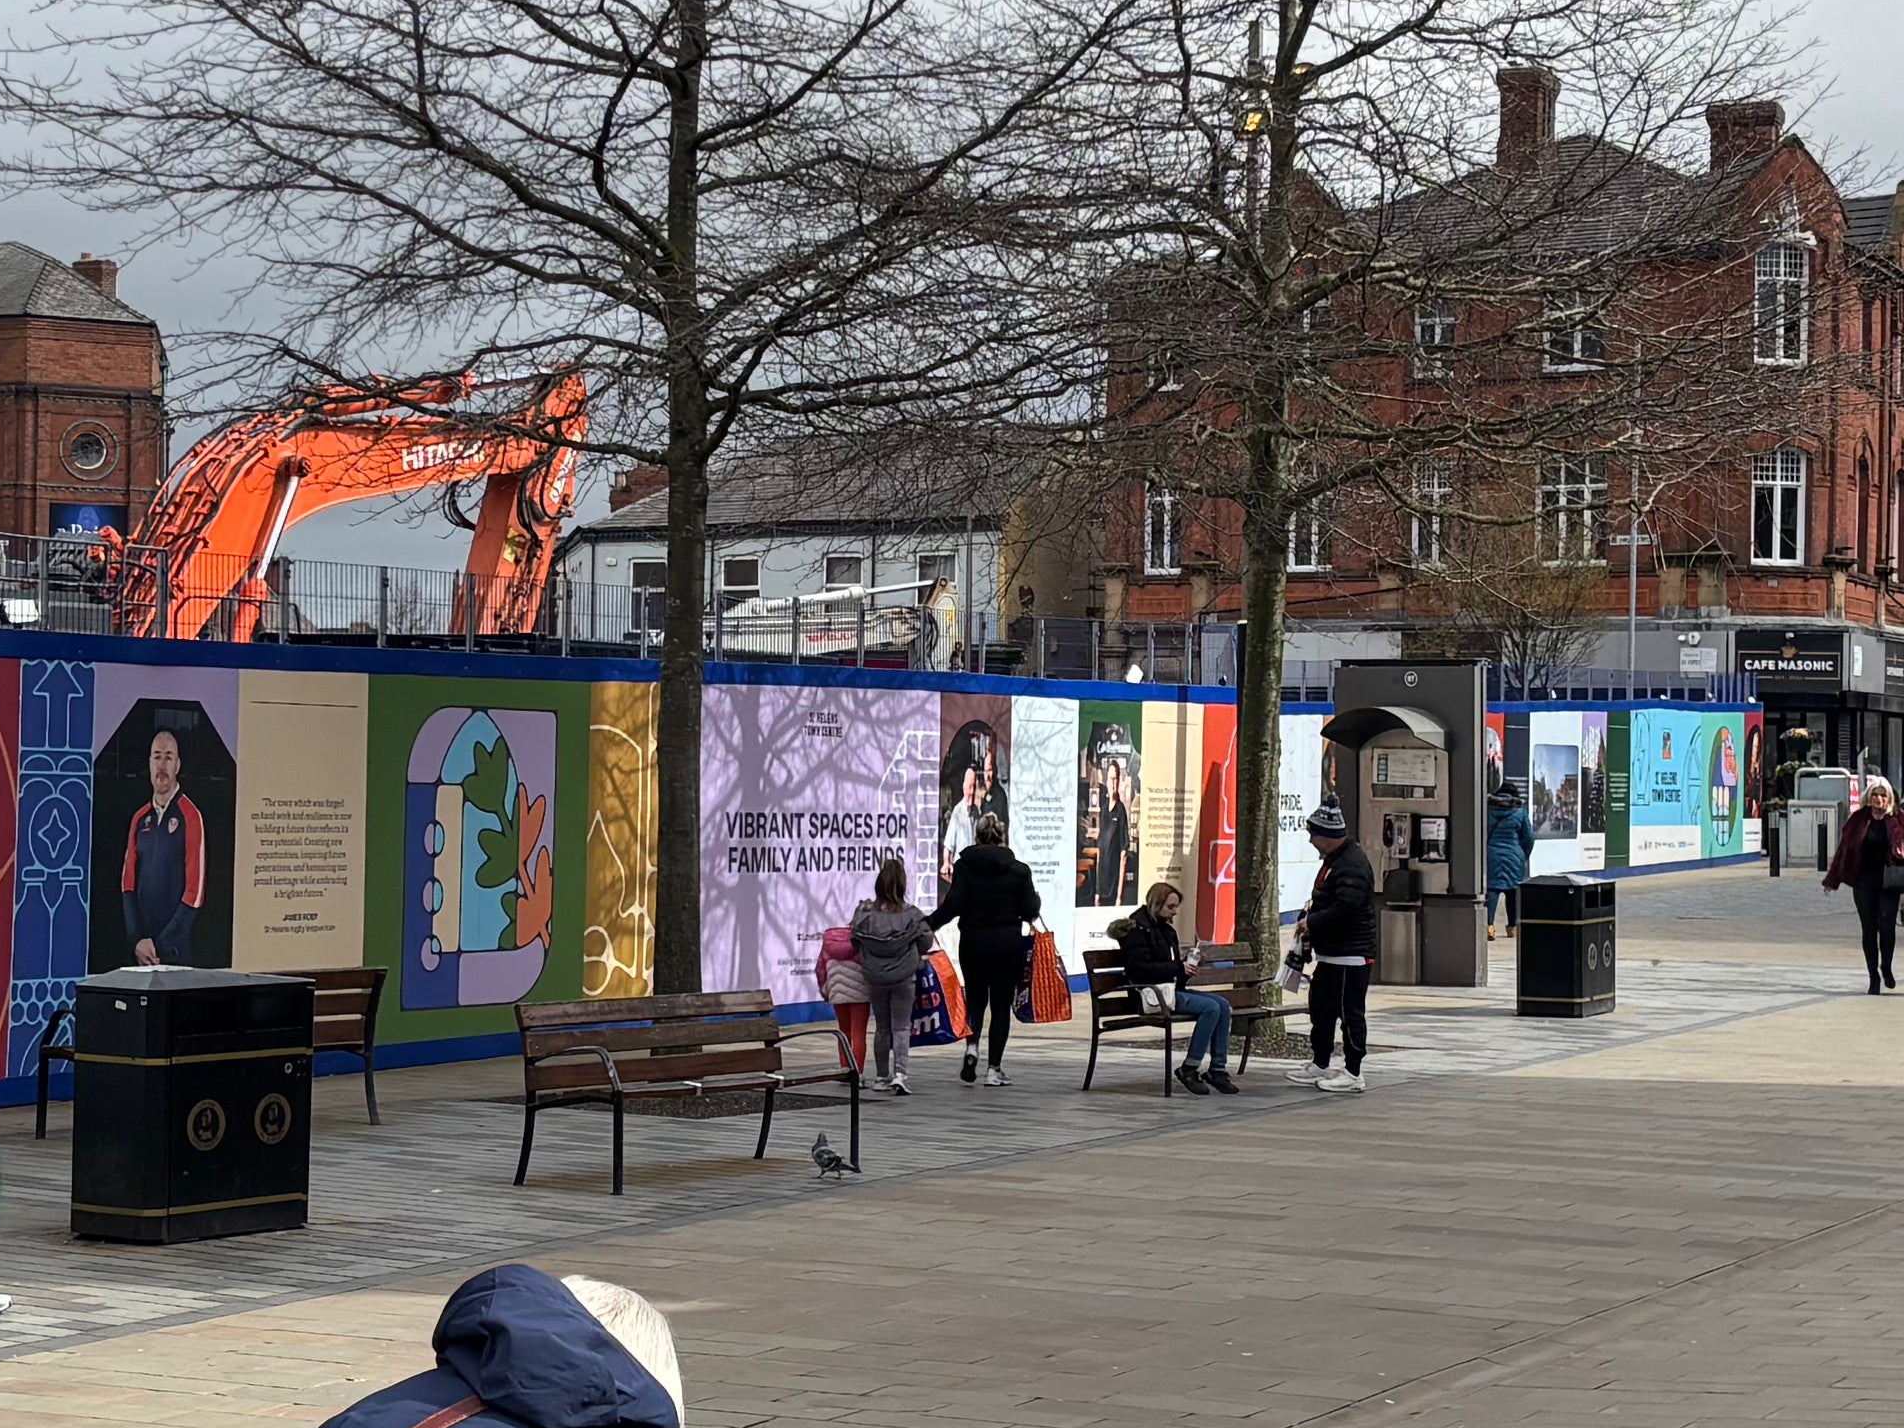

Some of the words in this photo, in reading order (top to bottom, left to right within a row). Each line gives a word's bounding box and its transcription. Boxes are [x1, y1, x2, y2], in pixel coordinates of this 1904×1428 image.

[1744, 659, 1776, 672] CAFE
[1778, 660, 1834, 672] MASONIC
[726, 811, 805, 839] VIBRANT
[808, 812, 873, 839] SPACES
[876, 813, 908, 839] FOR
[728, 846, 792, 873] FAMILY
[796, 846, 834, 872] AND
[837, 846, 905, 872] FRIENDS
